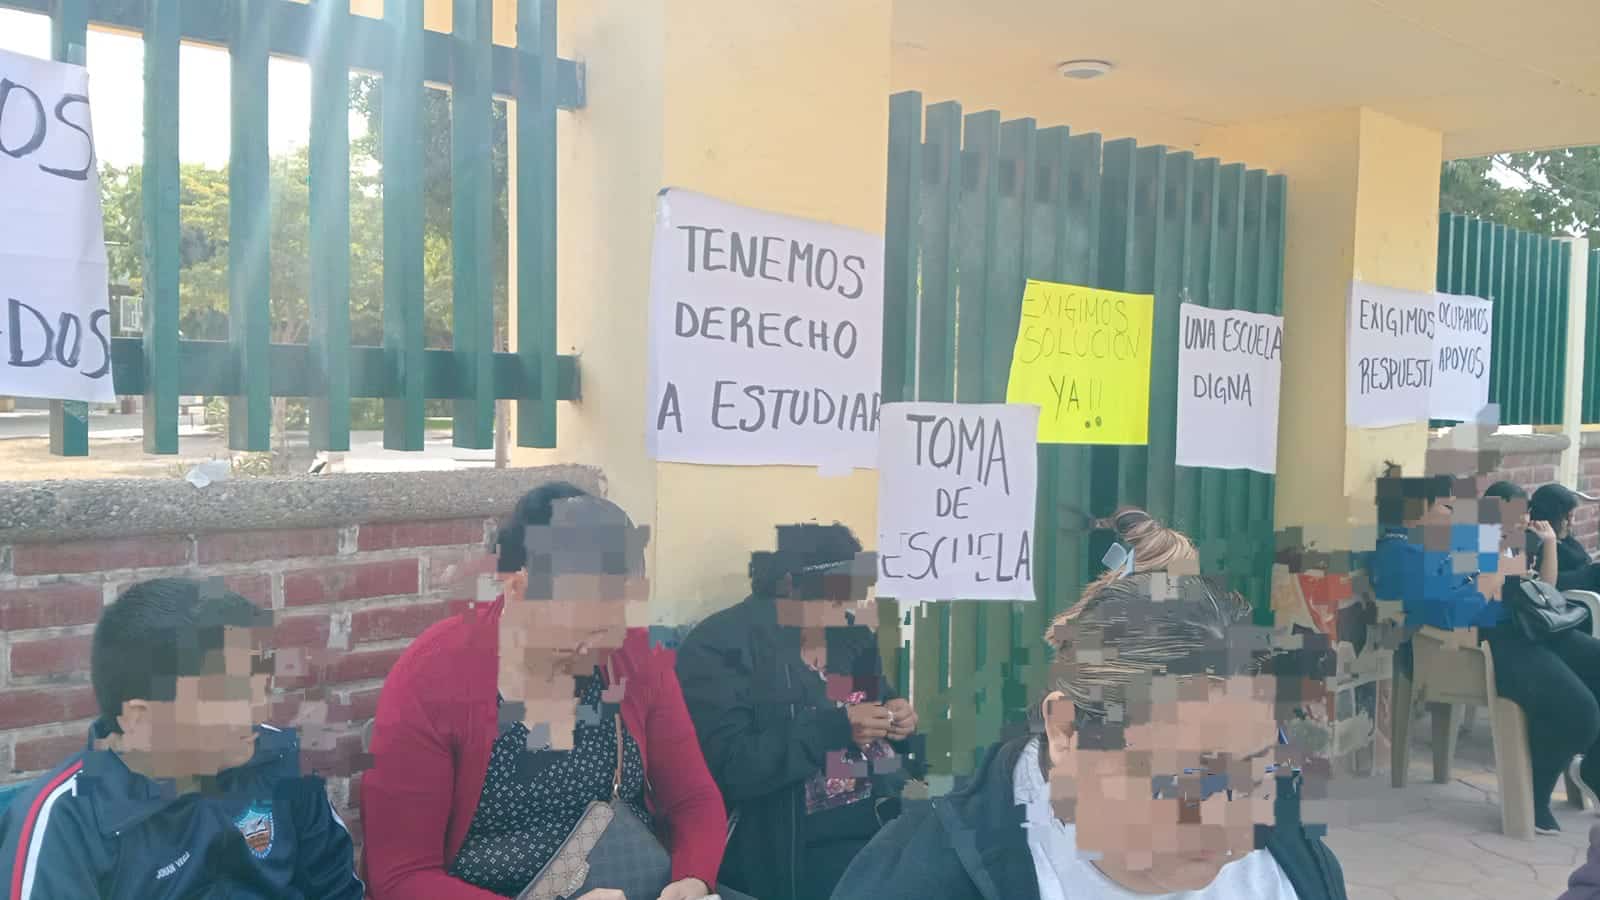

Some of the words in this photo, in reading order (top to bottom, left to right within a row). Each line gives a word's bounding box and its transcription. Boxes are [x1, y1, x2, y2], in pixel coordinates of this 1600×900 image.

[677, 225, 865, 299] TENEMOS
[0, 298, 110, 378] DOS
[675, 301, 857, 359] DERECHO
[1184, 316, 1216, 351] UNA
[1222, 317, 1284, 361] ESCUELA
[1359, 299, 1435, 340] EXIGIMOS
[1439, 301, 1489, 335] OCUPAMOS
[1438, 346, 1485, 379] APOYOS
[657, 381, 683, 433] A
[1193, 372, 1252, 407] DIGNA
[906, 413, 1010, 496] TOMA
[936, 486, 973, 519] DE
